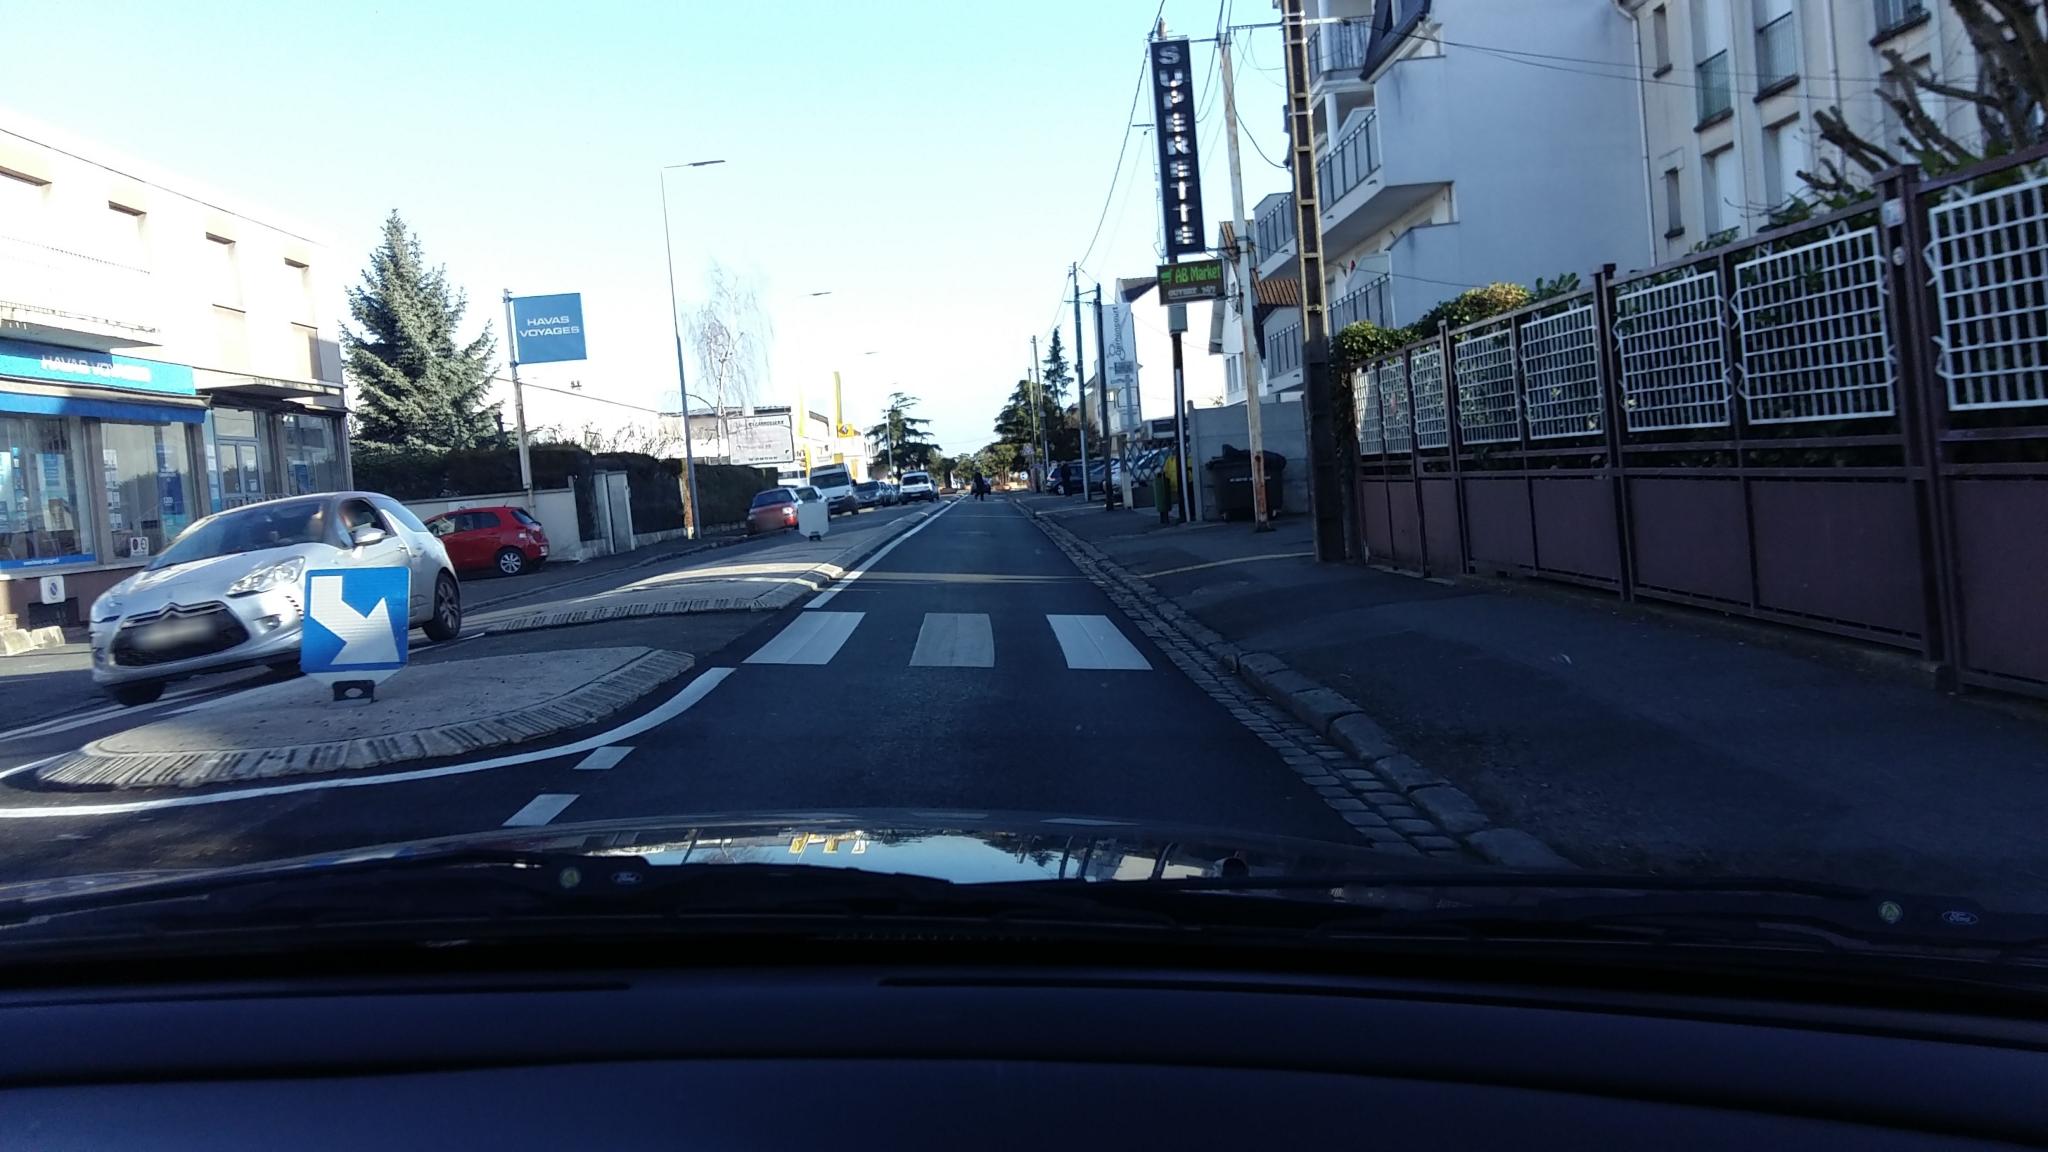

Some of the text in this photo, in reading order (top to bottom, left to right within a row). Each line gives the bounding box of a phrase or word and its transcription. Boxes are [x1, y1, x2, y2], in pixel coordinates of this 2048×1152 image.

[1158, 45, 1195, 245] SUPERETTE
[1175, 264, 1220, 283] AB Market
[527, 315, 570, 326] HAVAS
[520, 325, 580, 337] VOYAGES
